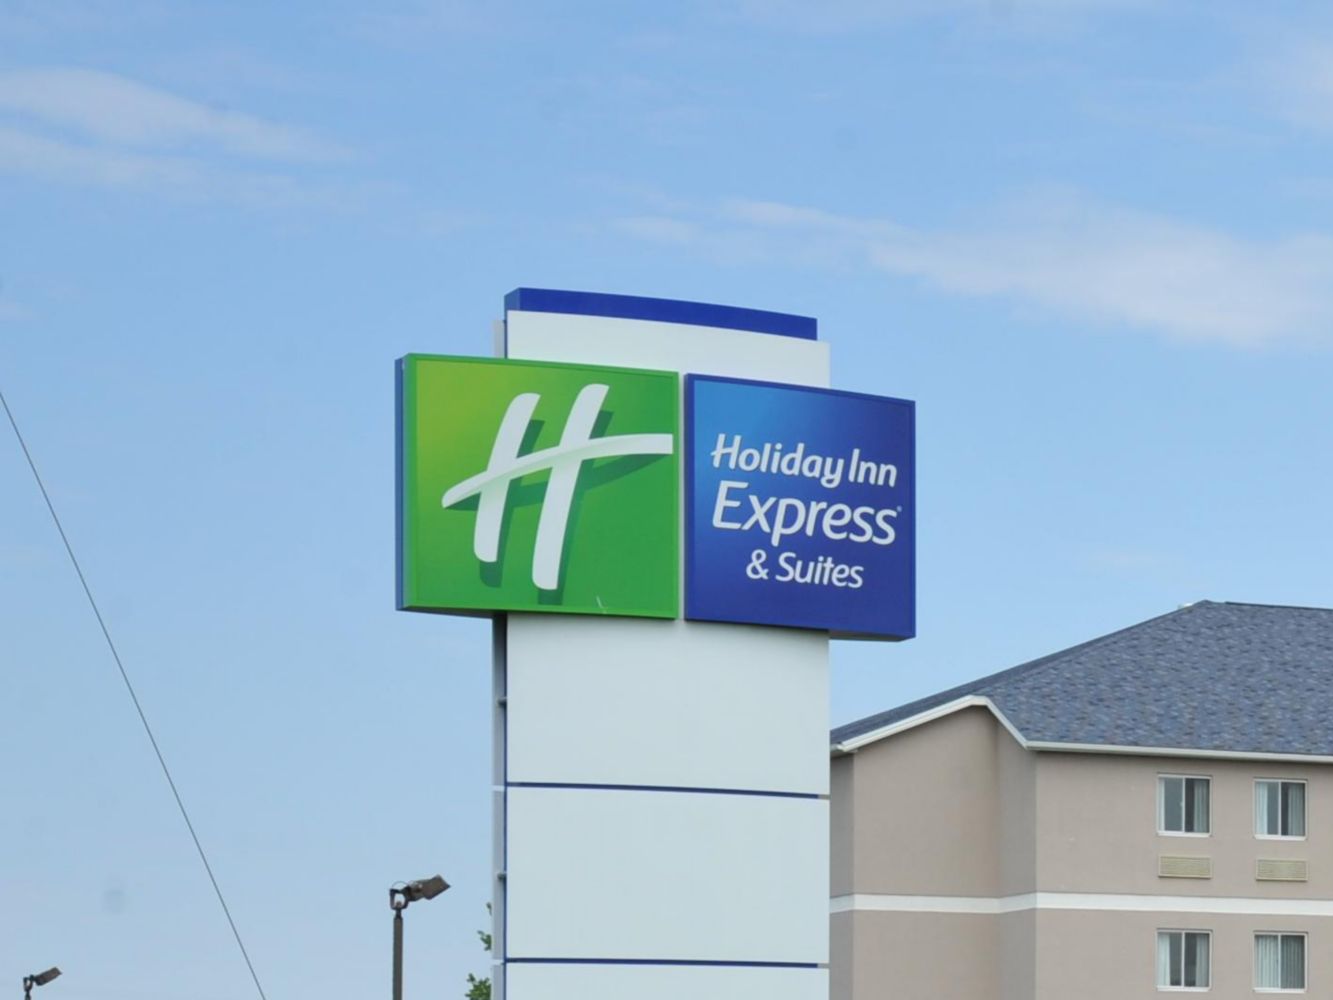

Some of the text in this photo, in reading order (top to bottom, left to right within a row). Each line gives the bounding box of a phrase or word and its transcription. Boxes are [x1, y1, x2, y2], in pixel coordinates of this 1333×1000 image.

[710, 432, 898, 489] Holiday Inn
[712, 479, 898, 548] Express
[745, 548, 865, 589] & Suites
